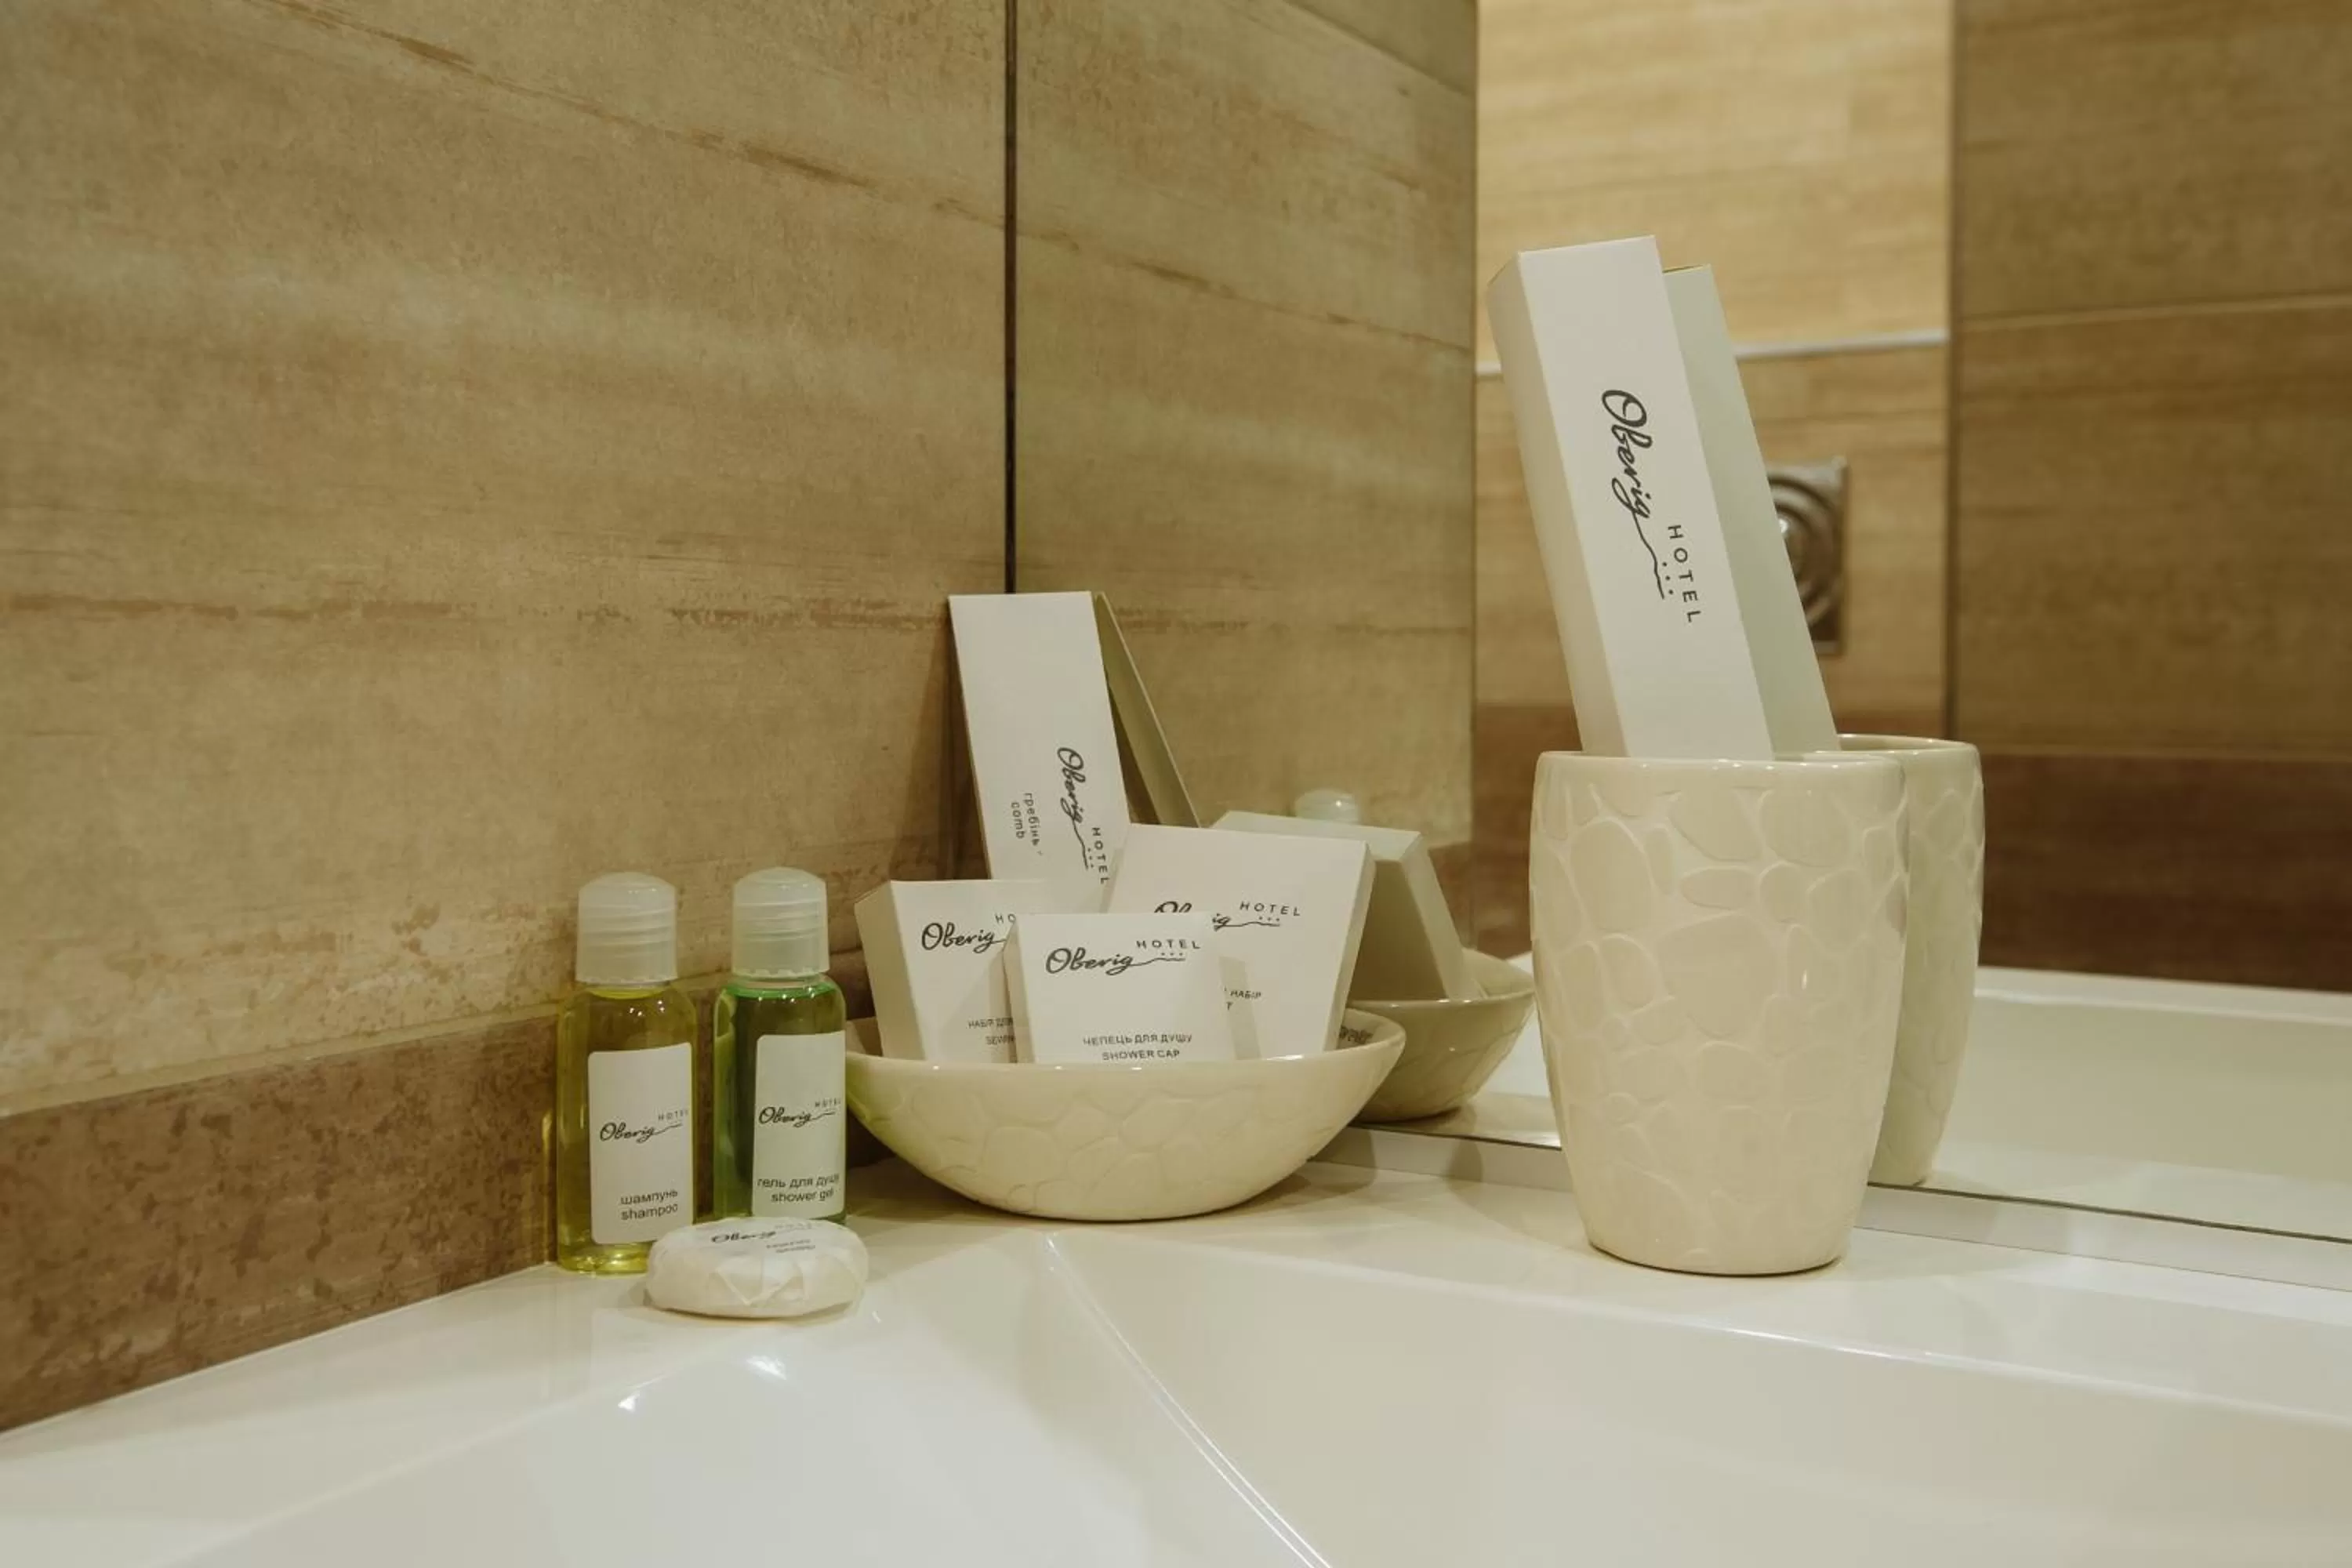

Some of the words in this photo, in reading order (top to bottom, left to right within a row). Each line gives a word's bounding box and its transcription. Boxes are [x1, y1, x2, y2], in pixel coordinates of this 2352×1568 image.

[1601, 390, 1656, 554] Oberig
[1668, 524, 1701, 623] HOTEL
[1057, 746, 1087, 842] Oberig
[1011, 801, 1025, 840] comb
[1091, 826, 1110, 884] HOTEL
[1239, 901, 1301, 916] HOTEL
[921, 921, 996, 954] Oberig
[1136, 939, 1200, 949] HOTEL
[1045, 946, 1134, 976] Oberig
[1134, 1033, 1158, 1044] ДЛЯ
[1160, 1033, 1192, 1044] ДУШУ
[1102, 1049, 1154, 1061] SHOWER
[1156, 1047, 1180, 1058] CAP
[758, 1106, 812, 1128] Oberig
[600, 1121, 656, 1144] Oberig
[620, 1189, 678, 1205] шампунь
[771, 1191, 817, 1203] shower
[620, 1203, 678, 1221] shampoo
